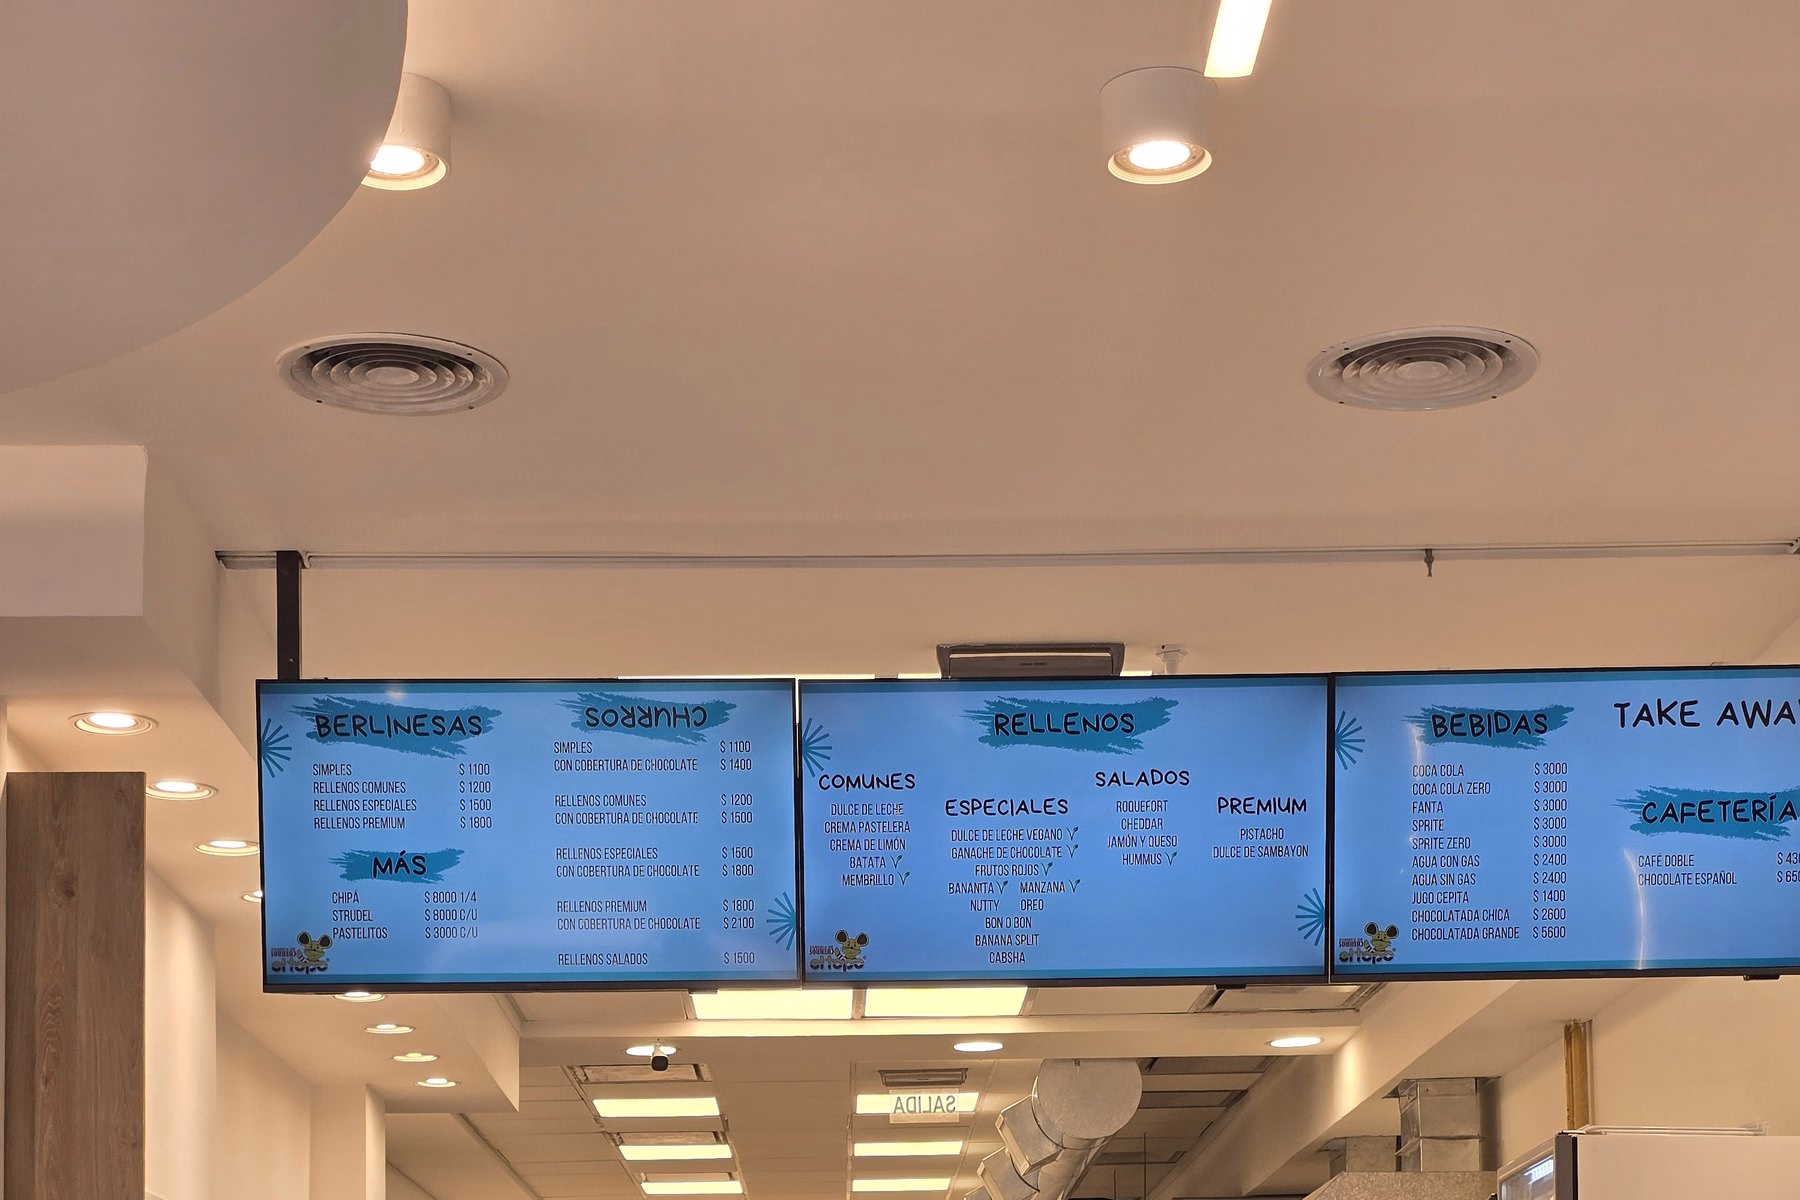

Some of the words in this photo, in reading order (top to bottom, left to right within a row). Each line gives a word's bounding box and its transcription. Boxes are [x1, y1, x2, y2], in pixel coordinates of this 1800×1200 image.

[585, 705, 707, 729] CHURROS
[1614, 699, 1701, 728] TAKE
[1717, 699, 1800, 729] AWA
[314, 714, 483, 738] BERLINESAS
[994, 711, 1135, 736] RELLENOS
[1431, 712, 1549, 738] BEBIDAS
[554, 742, 592, 754] SIMPLES
[729, 740, 750, 752] 1100
[313, 764, 352, 776] SIMPLES
[468, 763, 490, 776] 1100
[554, 759, 573, 771] CON
[575, 759, 629, 771] COBERTURA
[631, 759, 642, 771] DE
[645, 759, 697, 771] CHOCOLATE
[729, 758, 751, 771] 1400
[1412, 764, 1438, 777] COCA
[1440, 764, 1464, 777] COLA
[1542, 762, 1567, 775] 3000
[818, 773, 916, 791] COMUNES
[1095, 769, 1190, 787] SALADOS
[313, 781, 359, 794] RELLENOS
[362, 781, 406, 794] COMUNES
[468, 781, 491, 793] 1200
[1412, 782, 1438, 795] COCA
[1440, 782, 1463, 795] COLA
[1467, 782, 1490, 795] ZERO
[1542, 781, 1567, 793] 3000
[313, 799, 360, 811] RELLENOS
[362, 799, 417, 811] ESPECIALES
[469, 799, 492, 811] 1500
[555, 795, 601, 807] RELLENOS
[603, 795, 646, 807] COMUNES
[730, 794, 752, 806] 1200
[1116, 800, 1168, 813] ROQUEFORT
[1217, 797, 1307, 815] PREMIUM
[1412, 801, 1443, 814] FANTA
[1542, 799, 1567, 811] 3000
[831, 803, 859, 816] DULCE
[862, 803, 873, 816] DE
[875, 803, 904, 816] LECHE
[945, 798, 1068, 817] ESPECIALES
[1642, 795, 1798, 824] CAFETERÍA
[314, 817, 360, 829] RELLENOS
[363, 817, 405, 829] PREMIUM
[469, 816, 492, 829] 1800
[555, 812, 574, 824] CON
[576, 812, 629, 824] COBERTURA
[632, 812, 643, 824] DE
[646, 812, 698, 824] CHOCOLATE
[730, 812, 753, 824] 1500
[1121, 818, 1163, 830] CHEDDAR
[1412, 819, 1444, 832] SPRITE
[1542, 817, 1567, 830] 3000
[825, 821, 855, 833] CREMA
[859, 821, 910, 833] PASTELERA
[951, 829, 979, 841] DULCE
[982, 829, 994, 841] DE
[996, 829, 1024, 841] LECHE
[1026, 829, 1062, 841] VEGANO
[1240, 828, 1284, 840] PISTACHO
[830, 839, 861, 851] CREMA
[864, 839, 875, 851] DE
[878, 838, 905, 850] LIMÓN
[1107, 834, 1138, 848] JAMÓN
[1140, 836, 1146, 847] Y
[1148, 836, 1178, 847] QUESO
[1412, 837, 1444, 850] SPRITE
[1447, 837, 1470, 850] ZERO
[1542, 835, 1567, 848] 3000
[556, 848, 602, 860] RELLENOS
[604, 848, 658, 860] ESPECIALES
[731, 847, 753, 859] 1500
[951, 846, 994, 859] GANACHE
[996, 846, 1008, 859] DE
[1010, 846, 1062, 859] CHOCOLATE
[1213, 846, 1241, 858] DULCE
[1244, 846, 1255, 858] DE
[373, 850, 427, 878] MÁS
[850, 856, 886, 869] BATATA
[1122, 853, 1162, 865] HUMMUS
[1412, 855, 1438, 868] AGUA
[1440, 855, 1459, 868] CON
[1461, 855, 1480, 868] GAS
[1542, 854, 1567, 866] 2400
[1638, 853, 1661, 868] CAFÉ
[1664, 855, 1694, 867] DOBLE
[1786, 852, 1800, 865] 43
[557, 865, 575, 878] CON
[577, 865, 630, 878] COBERTURA
[633, 865, 644, 878] DE
[647, 865, 699, 878] CHOCOLATE
[731, 865, 754, 877] 1800
[975, 864, 1009, 876] FRUTOS
[1012, 864, 1039, 876] ROJOS
[842, 874, 894, 886] MEMBRILLO
[1412, 873, 1438, 886] AGUA
[1440, 873, 1455, 886] SIN
[1457, 873, 1476, 886] GAS
[1542, 872, 1567, 884] 2400
[1638, 873, 1693, 886] CHOCOLATE
[1695, 870, 1737, 885] ESPAÑOL
[948, 882, 994, 895] BANANITA
[1019, 881, 1065, 894] MANZANA
[332, 890, 359, 904] CHIPÁ
[433, 891, 456, 903] 8000
[460, 891, 476, 903] 1/4
[1412, 891, 1434, 904] JUGO
[1437, 891, 1469, 904] CEPITA
[1542, 890, 1565, 902] 1400
[557, 900, 602, 912] RELLENOS
[605, 900, 647, 912] PREMIUM
[732, 900, 754, 912] 1800
[970, 900, 1000, 912] NUTTY
[1020, 899, 1044, 911] OREO
[332, 909, 373, 922] STRUDEL
[433, 909, 457, 921] 8000
[459, 909, 478, 921] C/U
[1412, 909, 1480, 922] CHOCOLATADA
[1482, 909, 1509, 922] CHICA
[1541, 908, 1566, 921] 2600
[558, 918, 576, 930] CON
[578, 918, 632, 930] COBERTURA
[634, 918, 646, 930] DE
[648, 918, 700, 930] CHOCOLATE
[731, 917, 754, 929] 2100
[985, 917, 1003, 929] BON
[1006, 917, 1011, 929] O
[1014, 917, 1032, 929] BON
[332, 927, 387, 939] PASTELITOS
[433, 927, 457, 939] 3000
[460, 927, 478, 939] C/U
[1412, 928, 1480, 940] CHOCOLATADA
[1482, 928, 1520, 940] GRANDE
[1541, 927, 1566, 939] 5600
[976, 934, 1013, 947] BANANA
[1015, 934, 1039, 947] SPLIT
[558, 953, 603, 965] RELLENOS
[606, 953, 648, 965] SALADOS
[733, 953, 755, 964] 1500
[989, 952, 1025, 964] CABSHA
